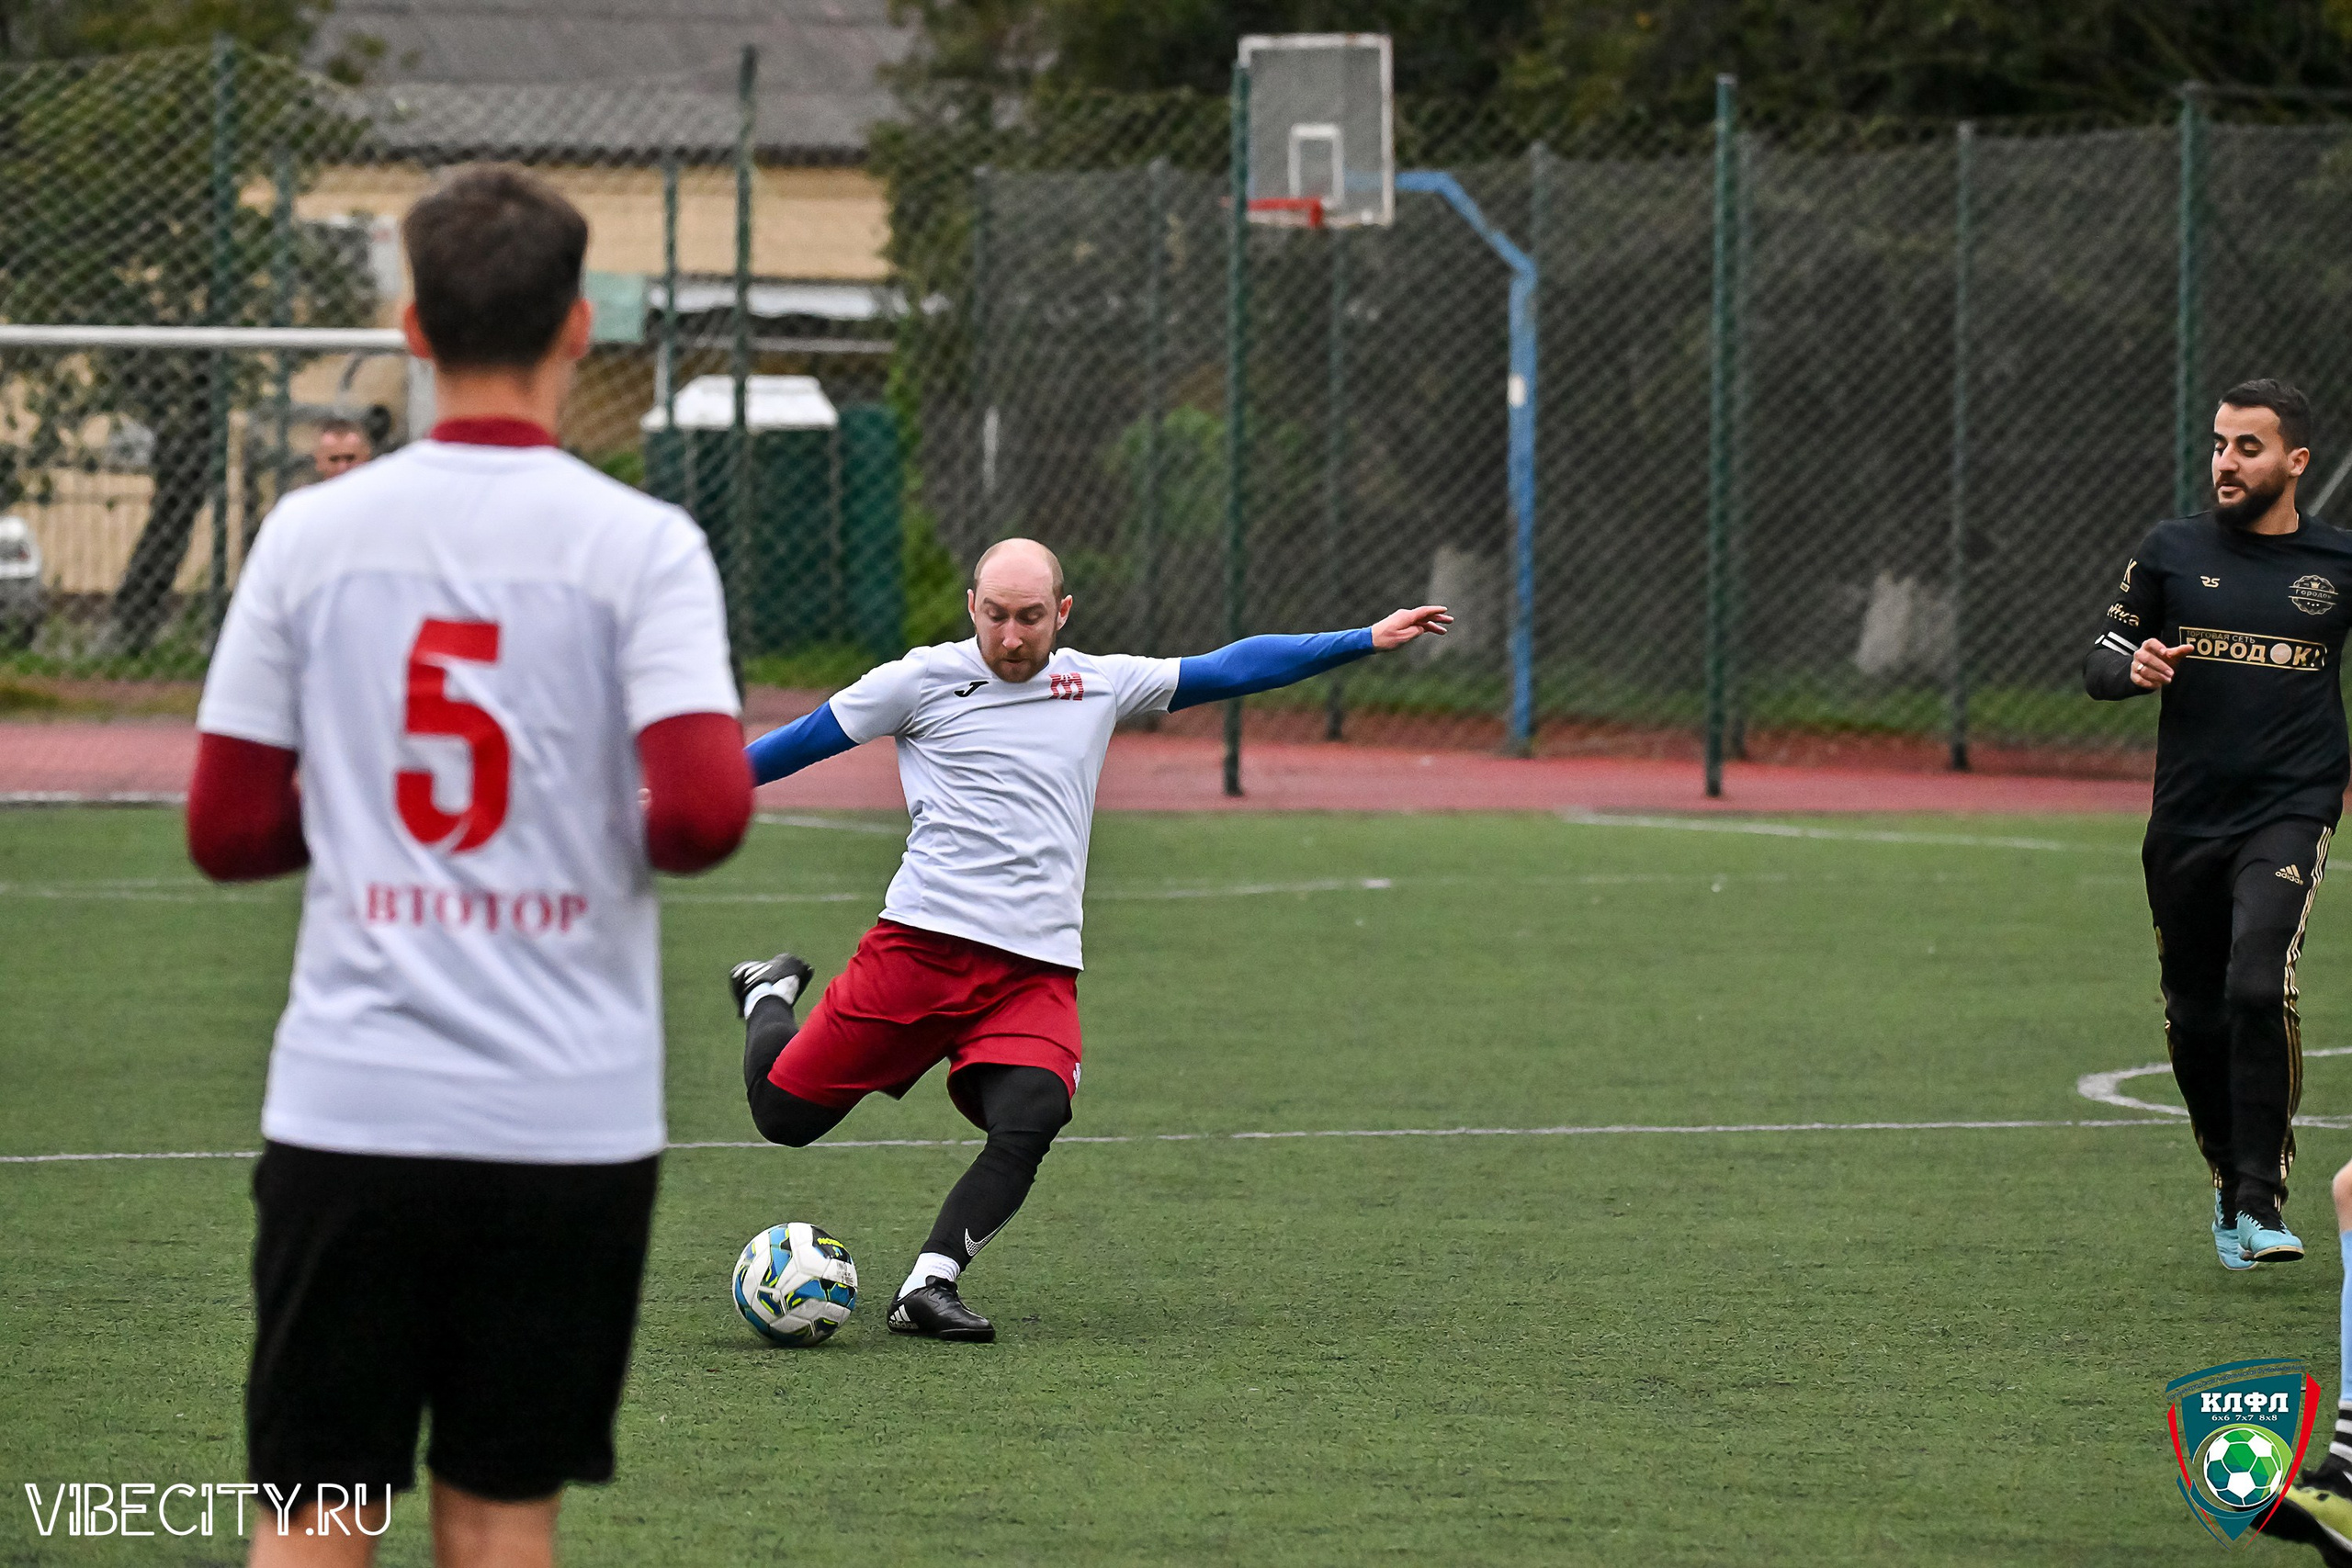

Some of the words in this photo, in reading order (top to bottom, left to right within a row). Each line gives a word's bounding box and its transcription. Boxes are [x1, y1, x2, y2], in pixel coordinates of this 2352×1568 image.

[2187, 629, 2230, 641] ТОРГОВАЯ
[2232, 635, 2256, 644] СЕТЬ
[394, 617, 511, 854] 5
